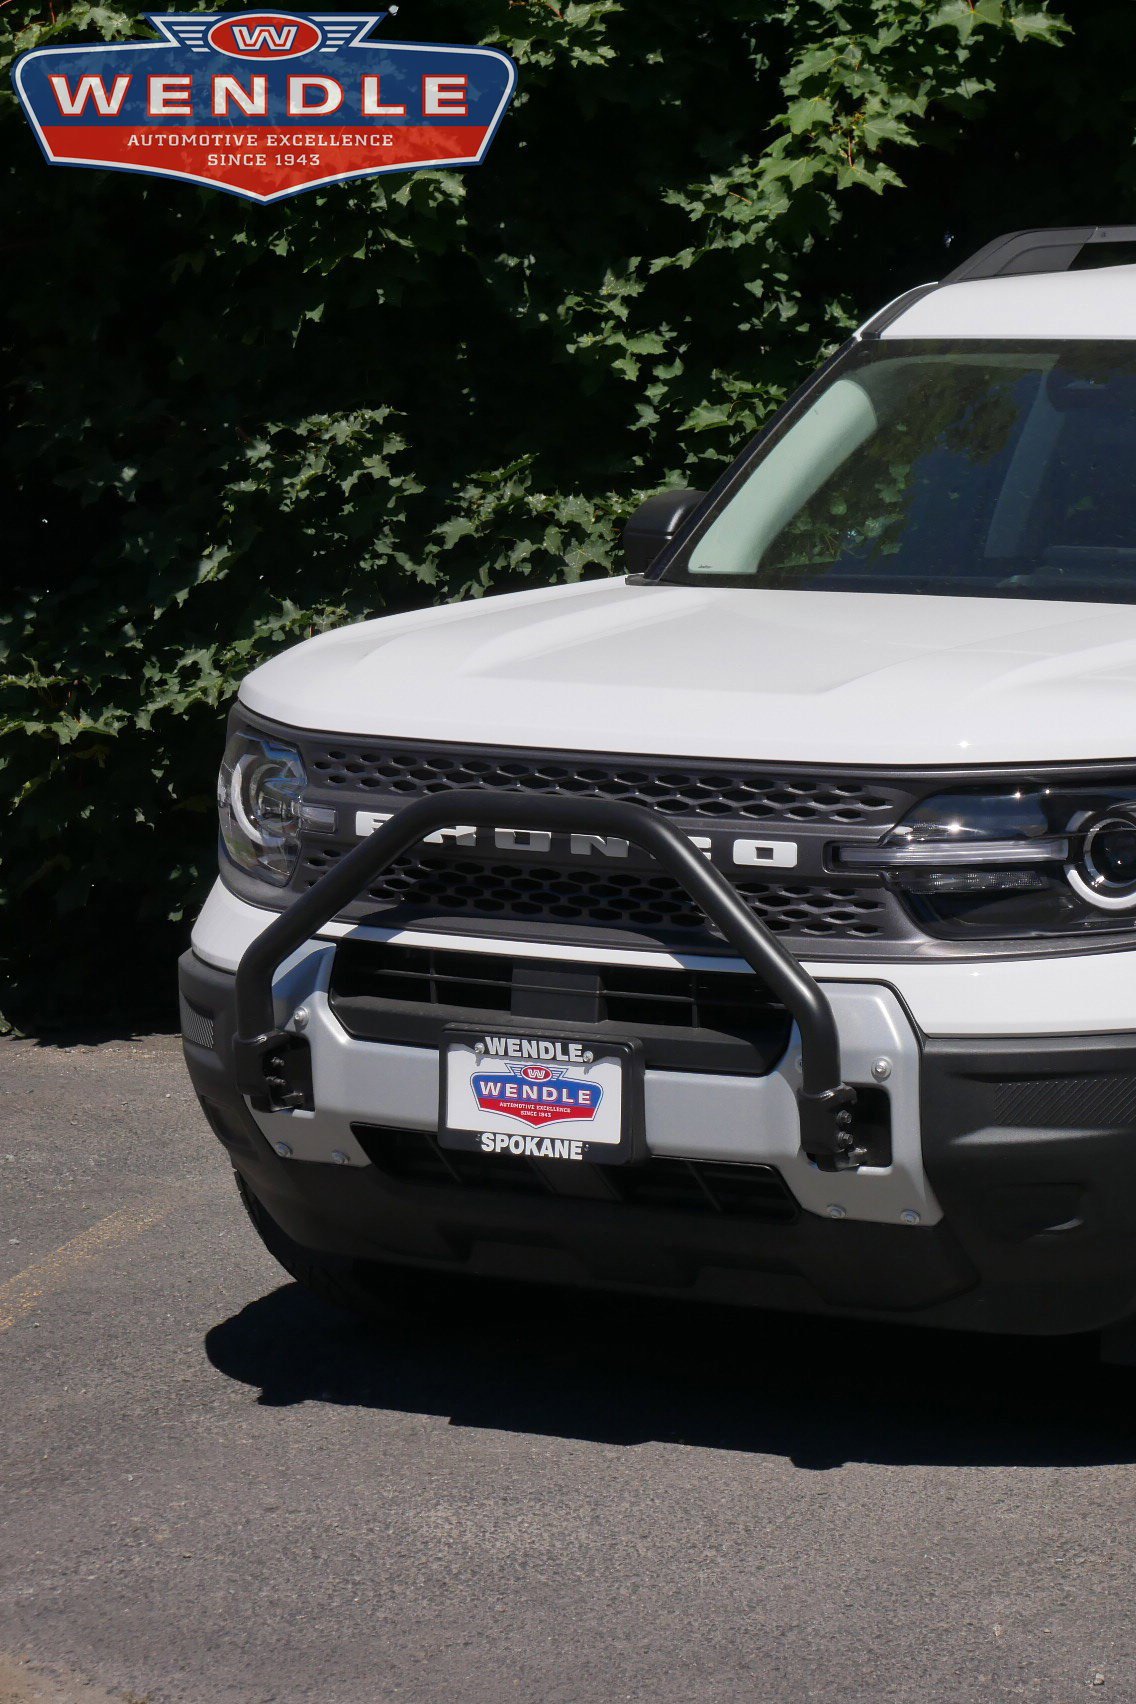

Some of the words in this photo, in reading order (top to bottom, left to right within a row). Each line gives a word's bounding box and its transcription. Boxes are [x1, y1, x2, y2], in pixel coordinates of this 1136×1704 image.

[484, 1036, 583, 1063] WENDLE
[479, 1081, 592, 1105] WENDLE
[499, 1101, 536, 1110] AUTOMOTIVE
[480, 1132, 583, 1161] SPOKANE
